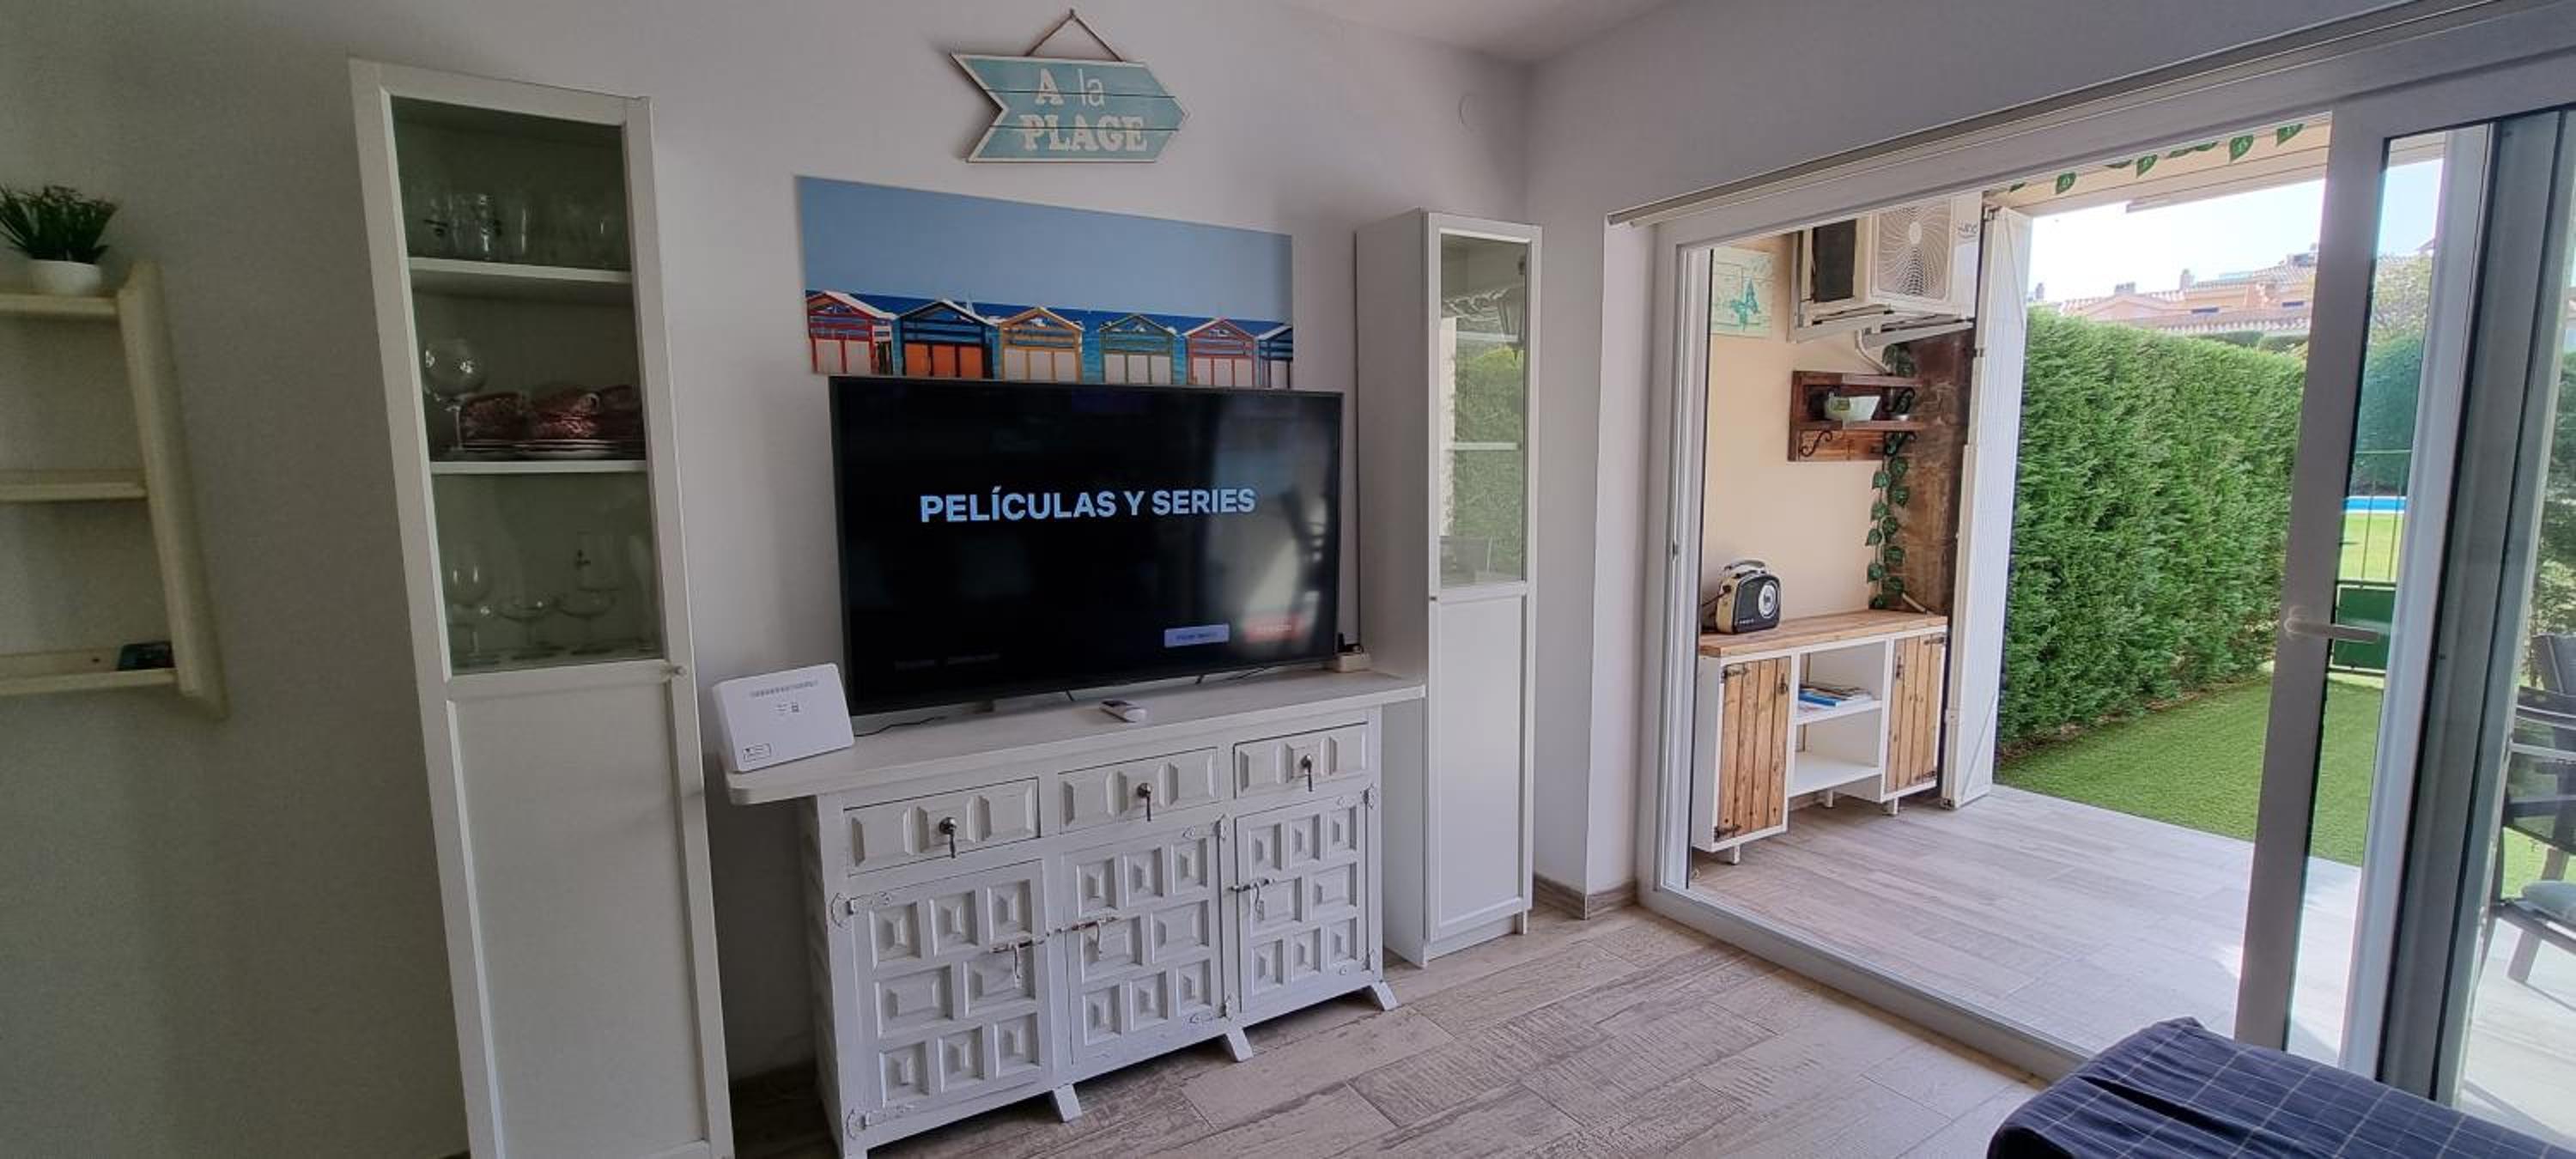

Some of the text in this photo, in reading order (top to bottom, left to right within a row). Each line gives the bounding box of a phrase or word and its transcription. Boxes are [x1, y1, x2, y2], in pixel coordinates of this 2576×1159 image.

[1035, 68, 1105, 106] A la
[1018, 114, 1148, 152] PLAGE
[920, 485, 1256, 523] PELÍCULAS Y SERIES
